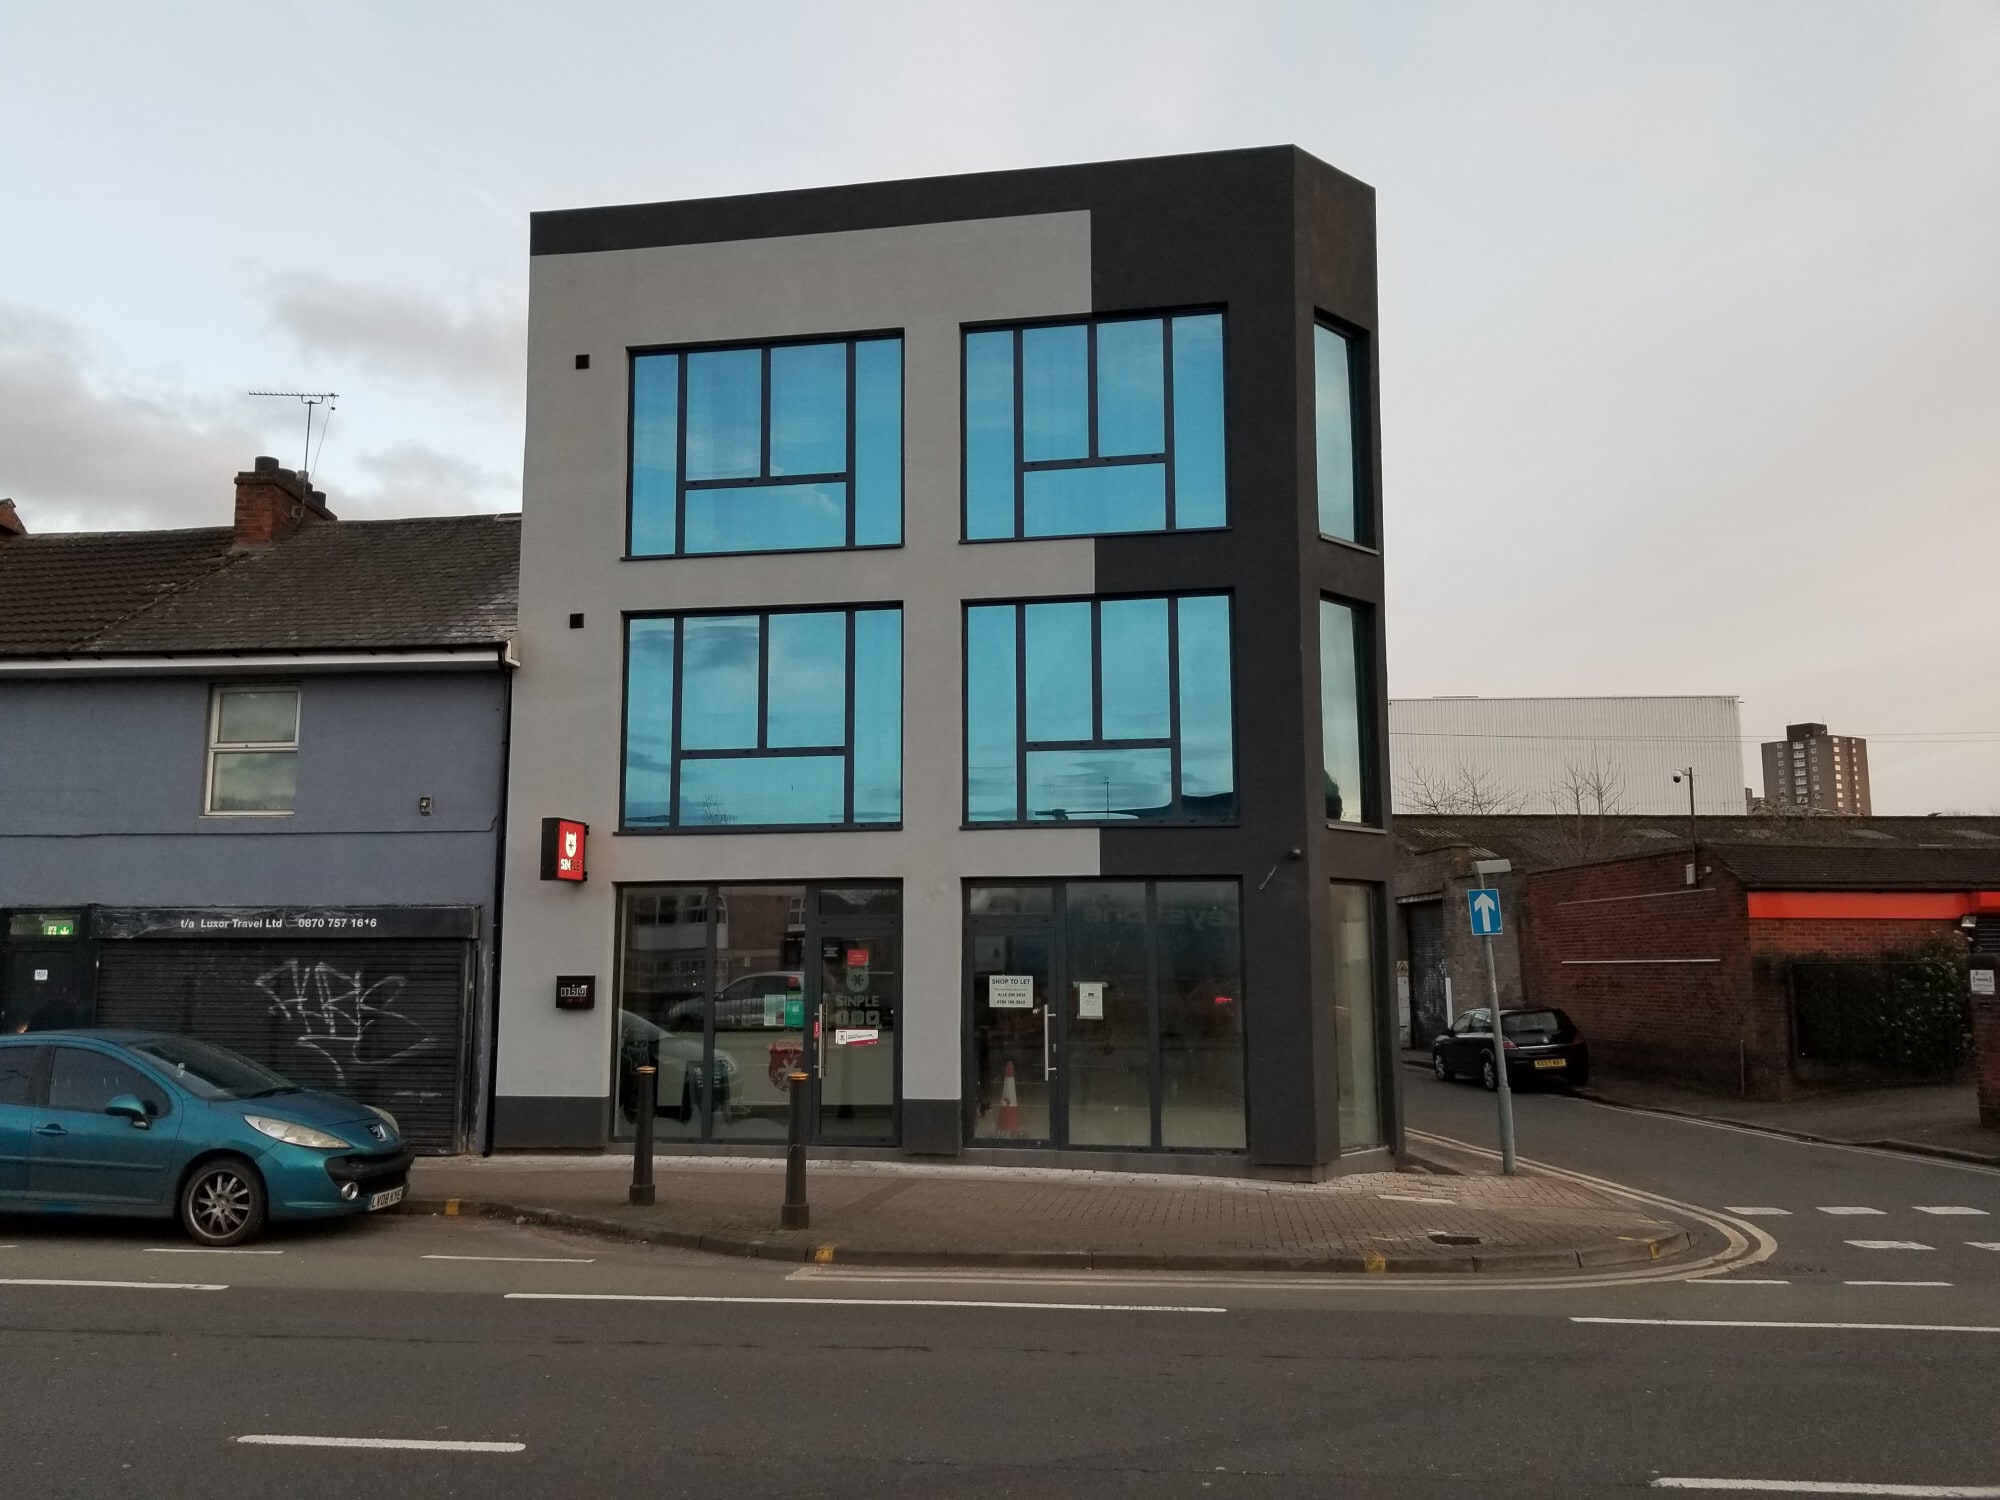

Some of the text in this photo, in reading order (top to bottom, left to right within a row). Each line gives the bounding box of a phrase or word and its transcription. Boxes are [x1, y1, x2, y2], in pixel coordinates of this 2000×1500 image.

[180, 919, 195, 928] t/a
[200, 918, 228, 928] Luxor
[231, 918, 263, 928] Travel
[265, 918, 283, 928] Ltd
[298, 918, 325, 928] 0870
[328, 918, 347, 928] 757
[836, 995, 880, 1007] SINPLE
